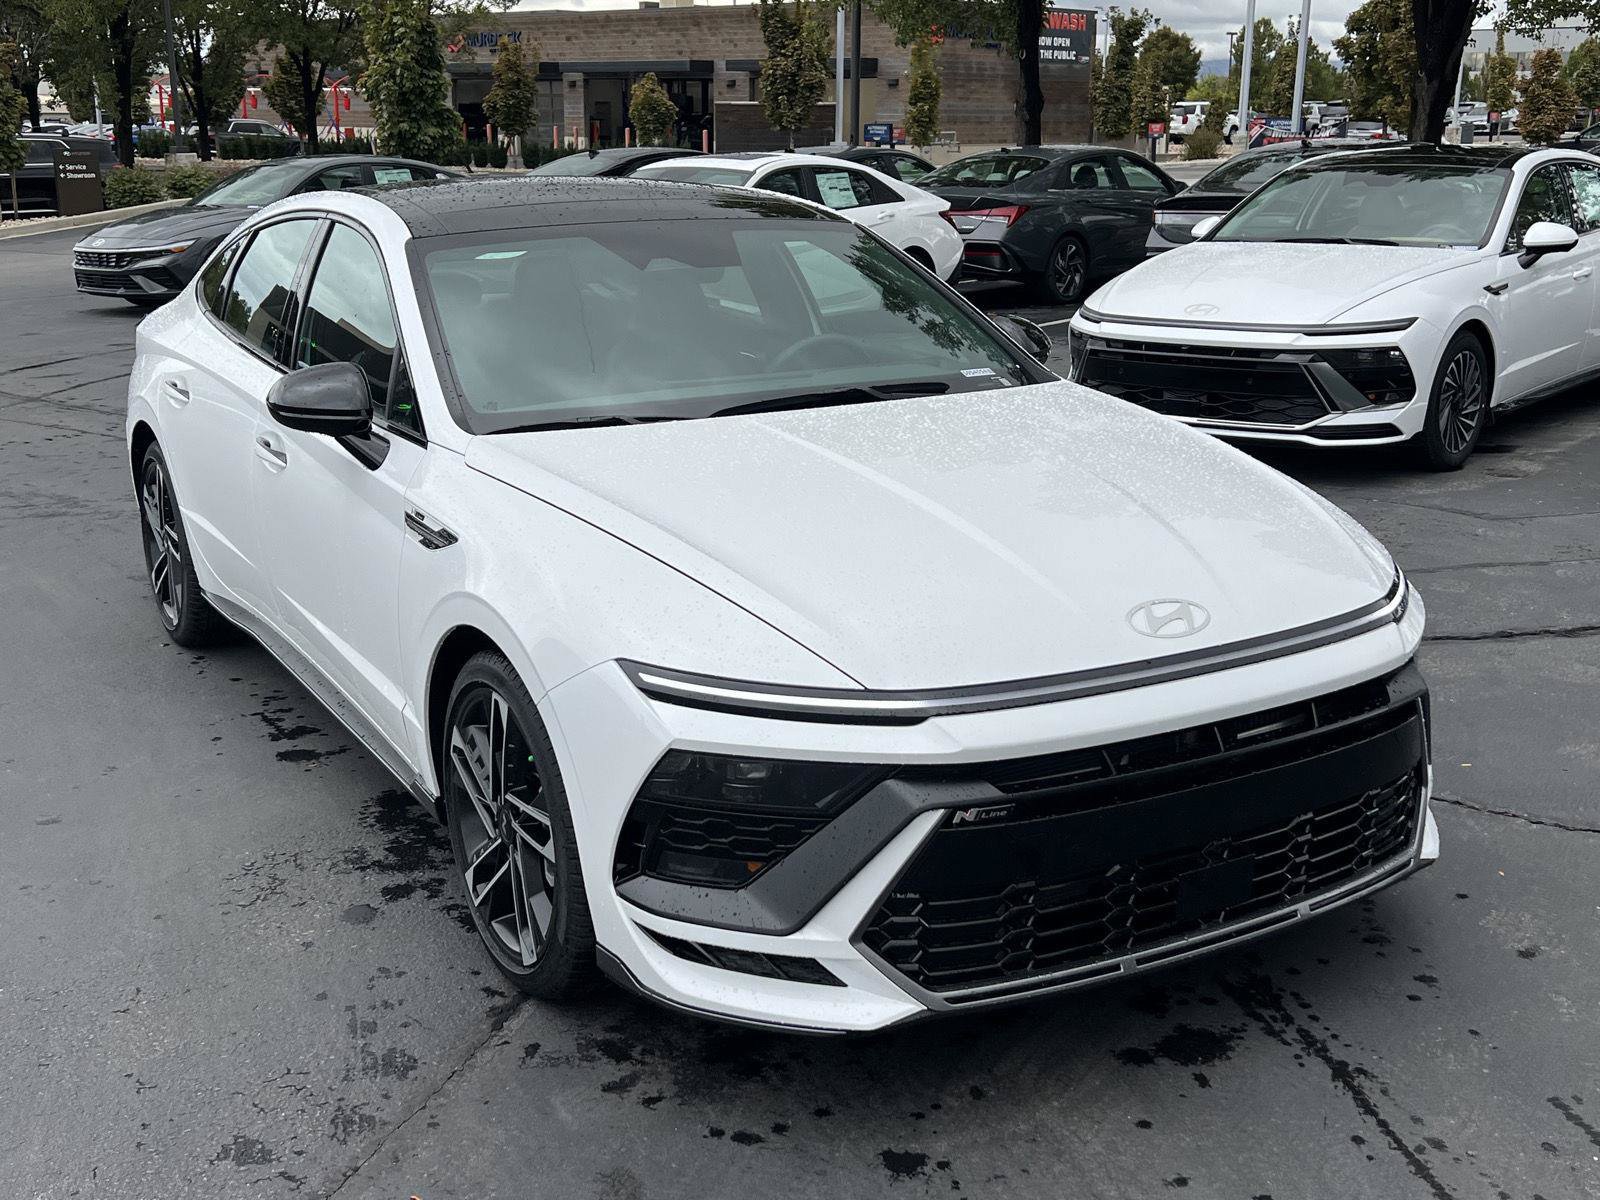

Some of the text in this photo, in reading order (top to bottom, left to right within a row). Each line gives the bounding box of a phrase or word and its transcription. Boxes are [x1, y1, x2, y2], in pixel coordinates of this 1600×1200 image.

[1053, 37, 1071, 47] OPEN
[1040, 49, 1053, 59] THE
[1053, 50, 1077, 60] PUBLIC
[980, 810, 1008, 819] Line
